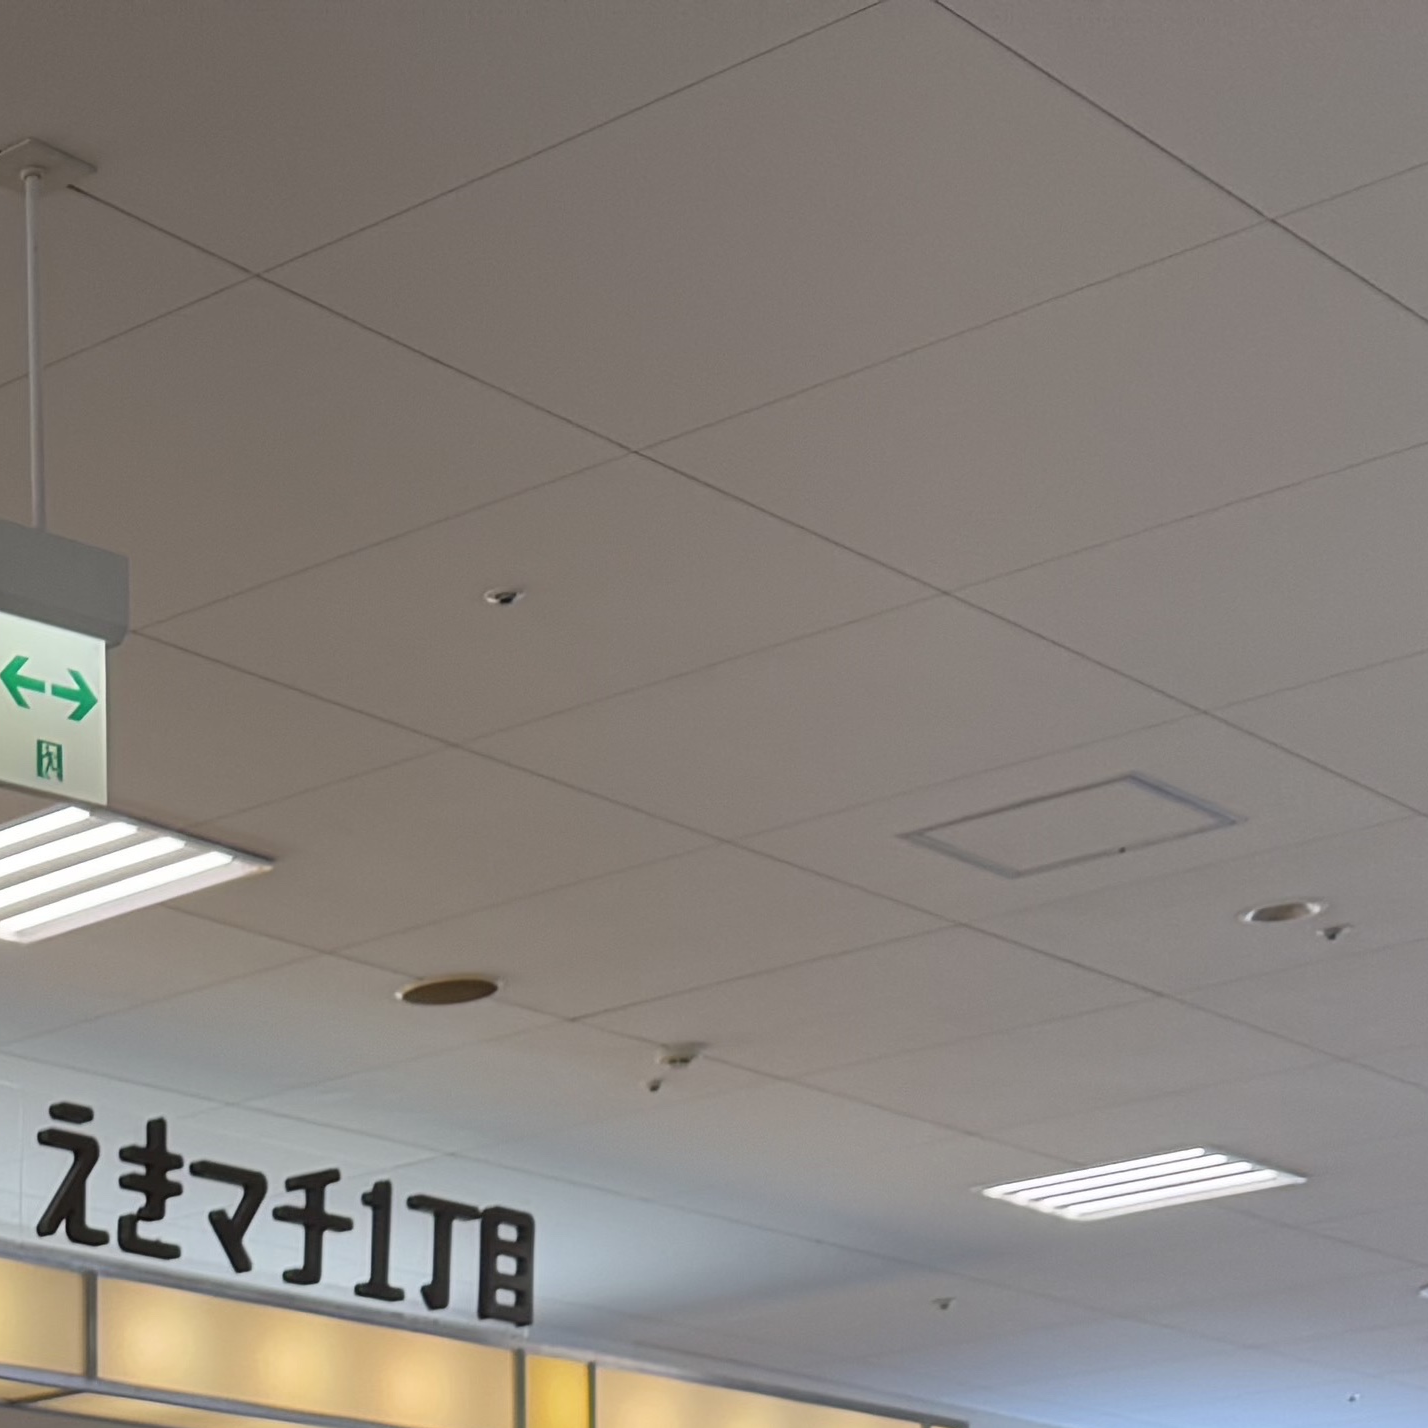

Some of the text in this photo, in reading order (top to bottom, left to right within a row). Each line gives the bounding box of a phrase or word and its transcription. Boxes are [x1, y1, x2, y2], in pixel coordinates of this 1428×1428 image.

[37, 1101, 535, 1326] えきマチ1丁目
